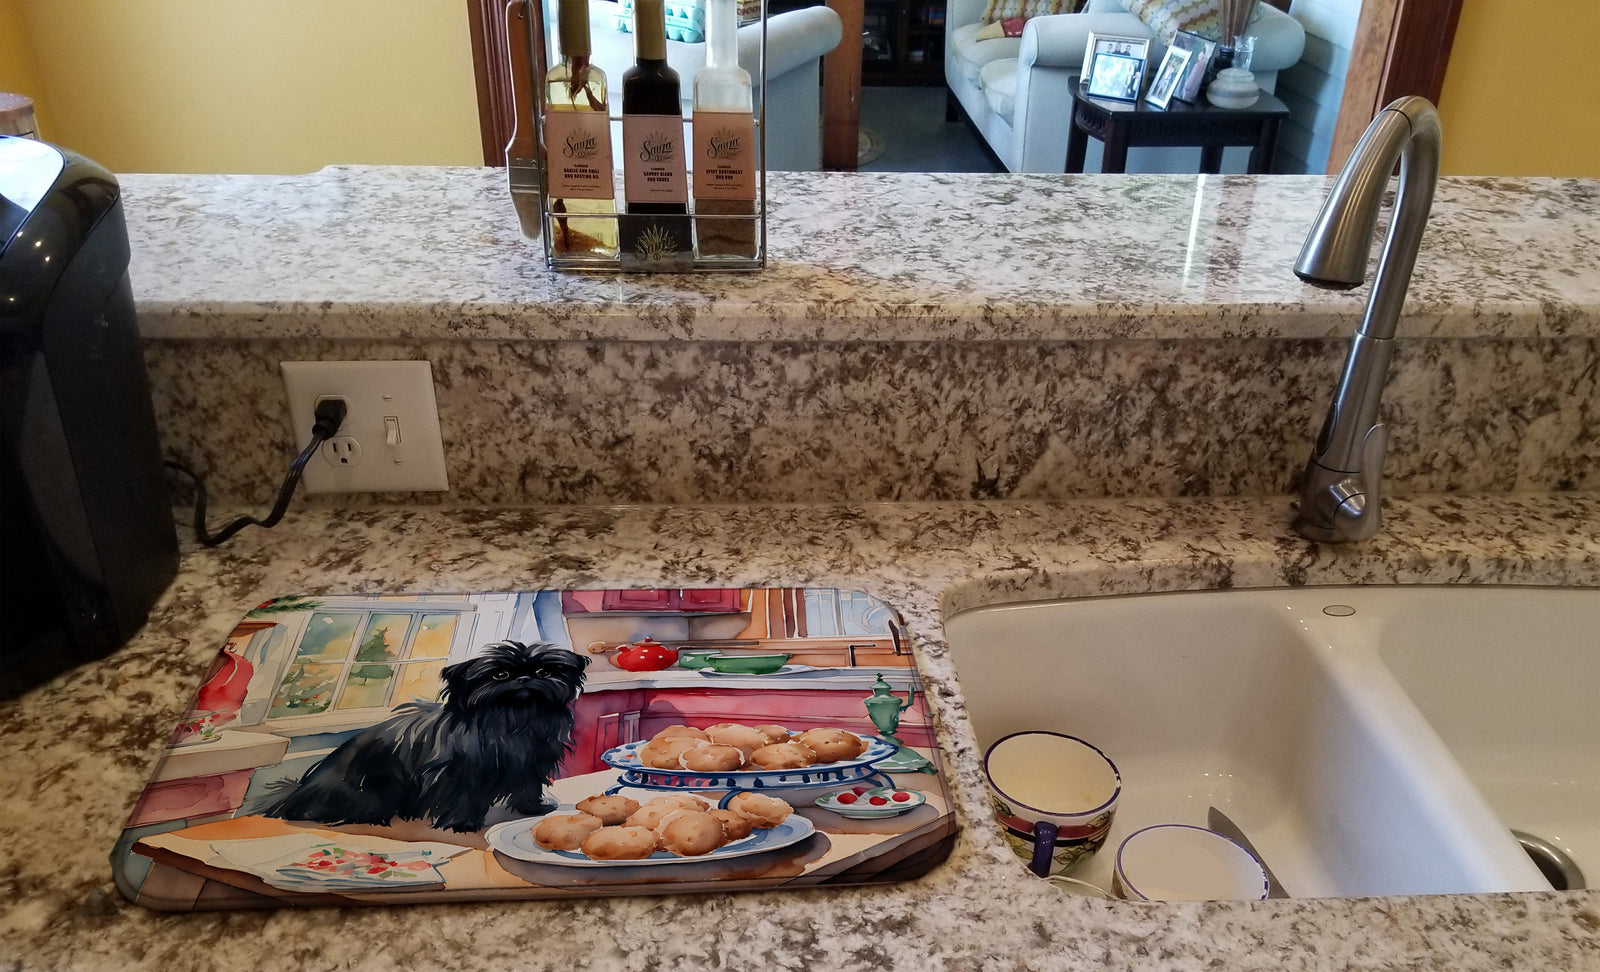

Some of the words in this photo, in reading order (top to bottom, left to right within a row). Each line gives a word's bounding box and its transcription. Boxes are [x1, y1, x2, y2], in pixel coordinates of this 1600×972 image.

[562, 136, 596, 157] Sauza
[640, 139, 673, 161] Sauza
[707, 137, 738, 158] Sauza
